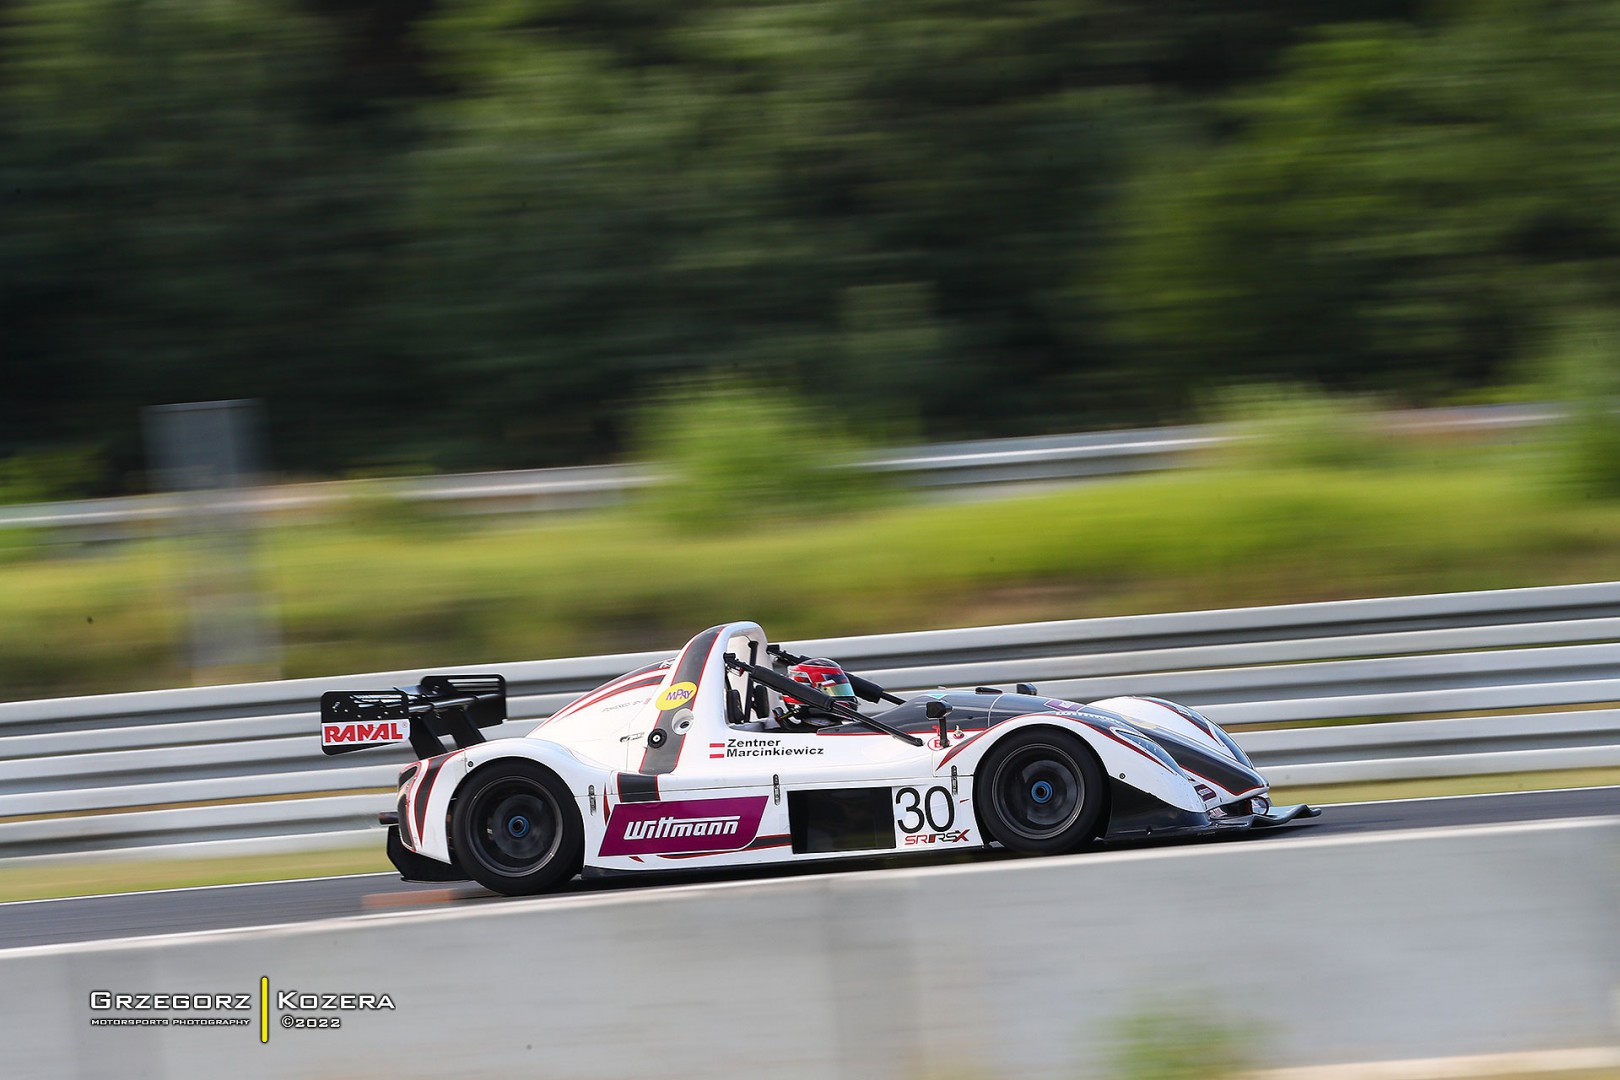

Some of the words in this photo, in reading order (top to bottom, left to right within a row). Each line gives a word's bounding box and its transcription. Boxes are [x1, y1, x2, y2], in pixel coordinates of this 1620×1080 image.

[727, 738, 781, 748] Zentner
[726, 746, 825, 758] Marcinkiewicz
[896, 785, 955, 834] 30
